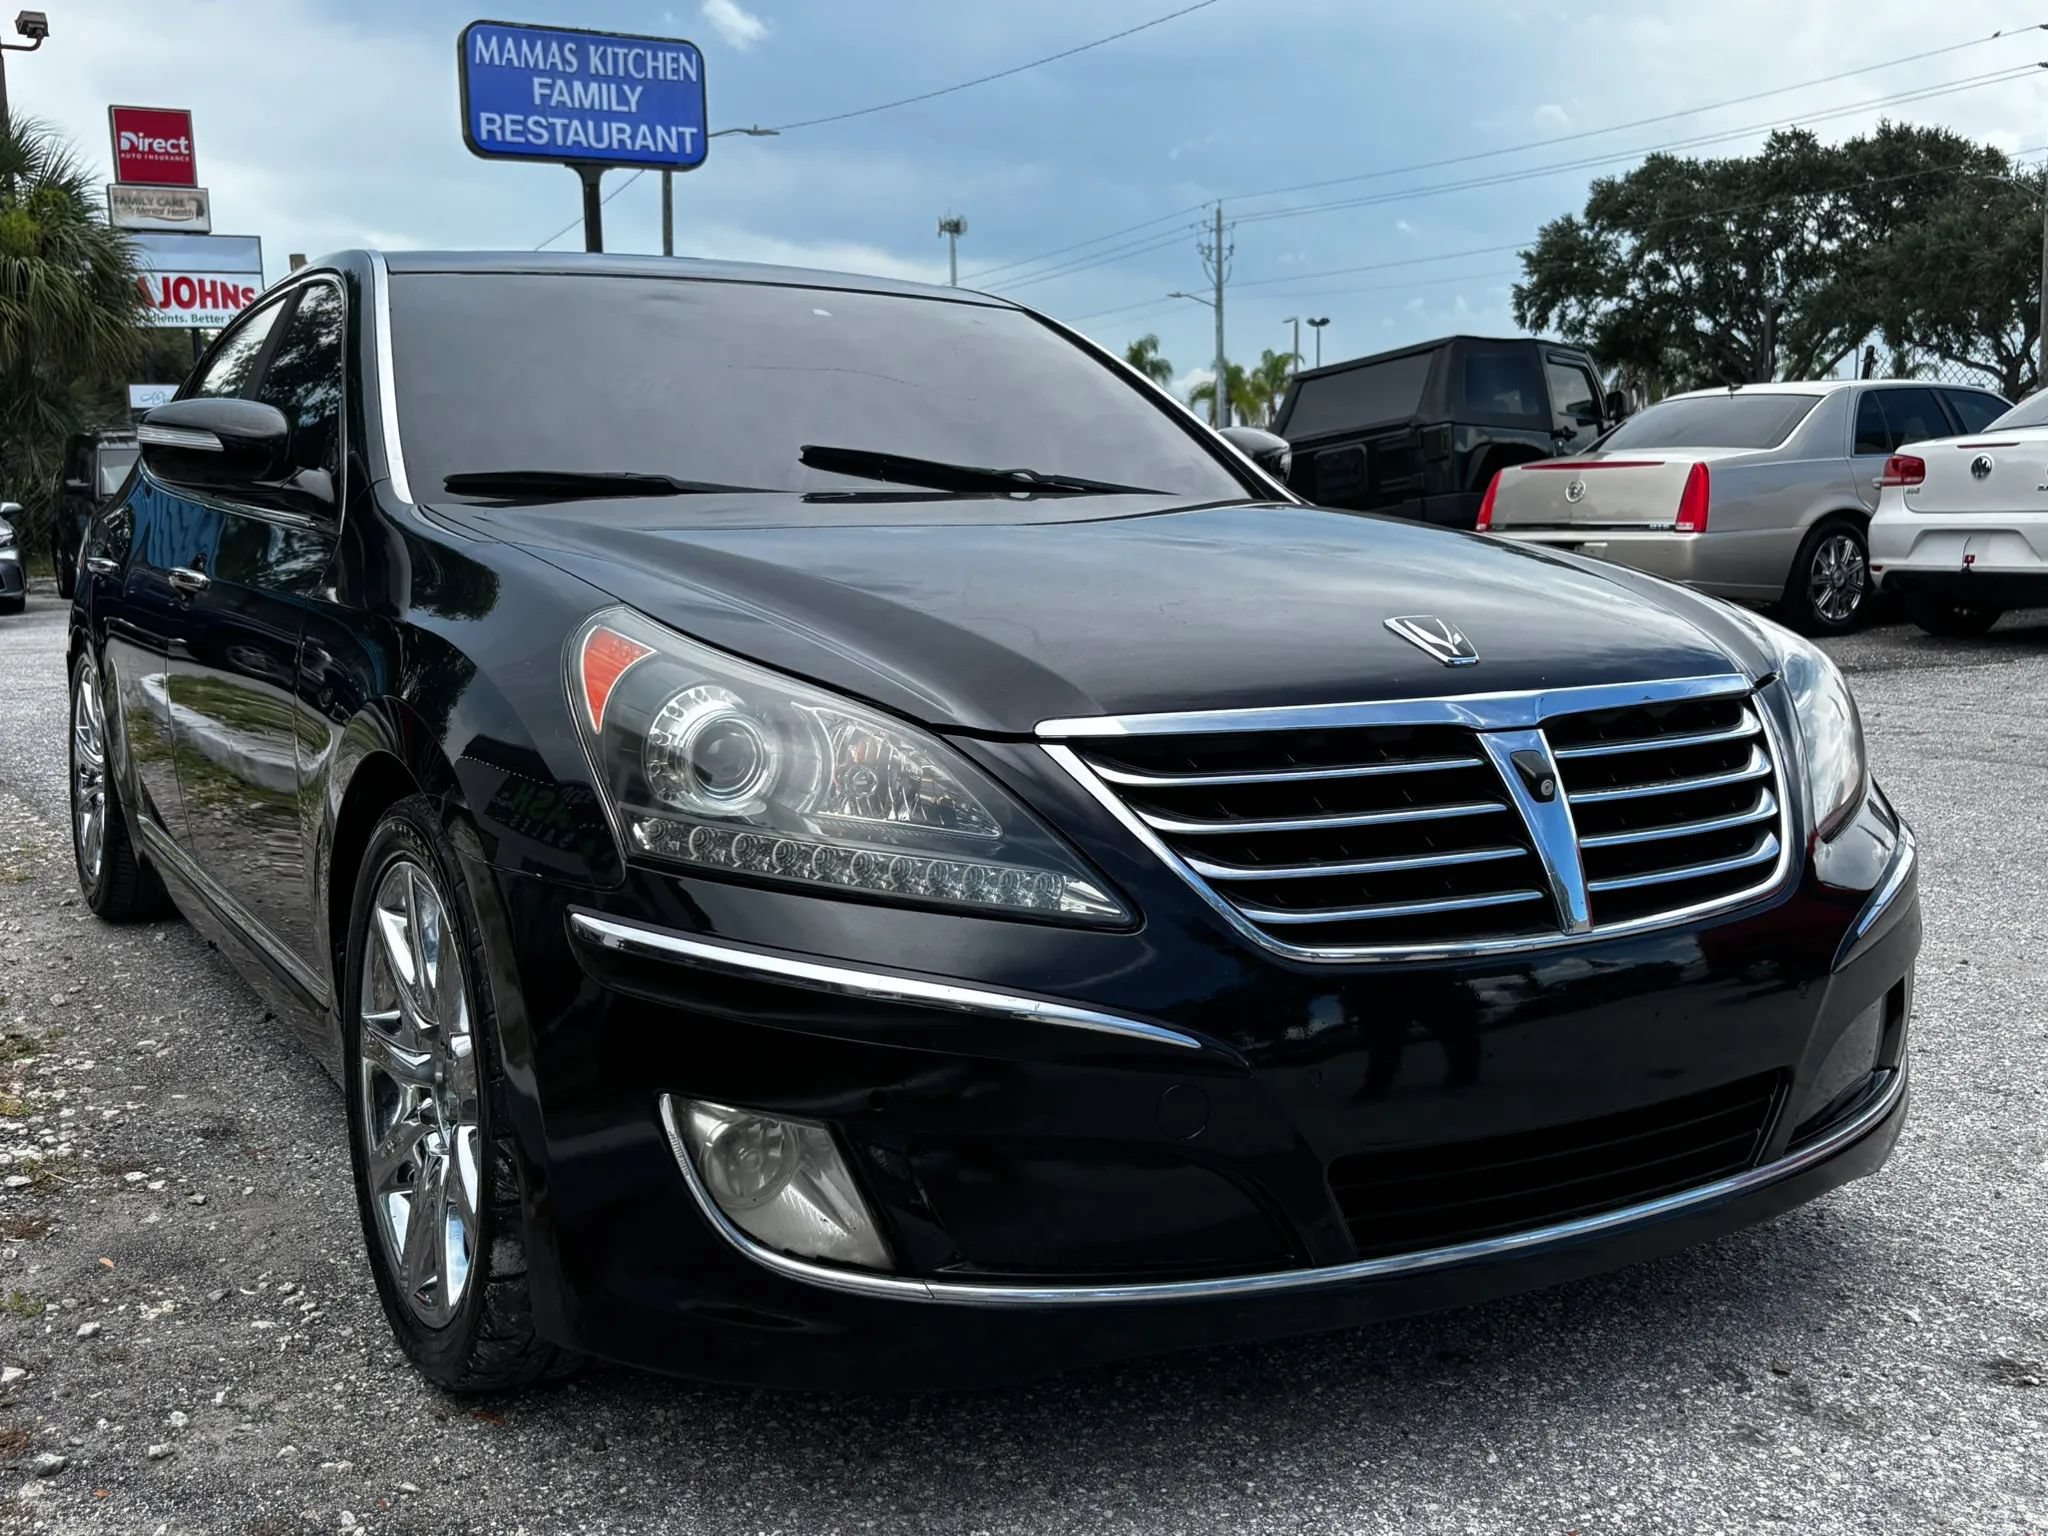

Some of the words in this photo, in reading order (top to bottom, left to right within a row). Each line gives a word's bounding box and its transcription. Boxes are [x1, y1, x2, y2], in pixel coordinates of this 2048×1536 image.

[475, 34, 578, 73] MAMAS
[589, 44, 698, 83] KITCHEN
[532, 77, 643, 113] FAMILY
[479, 112, 698, 154] RESTAURANT
[120, 131, 190, 154] Direct
[120, 152, 142, 160] AUTO
[144, 153, 190, 162] INSURANCE
[113, 195, 154, 206] FAMILY
[156, 197, 186, 208] CARE
[135, 206, 165, 216] Mental
[167, 207, 194, 217] Health
[191, 313, 225, 324] Better
